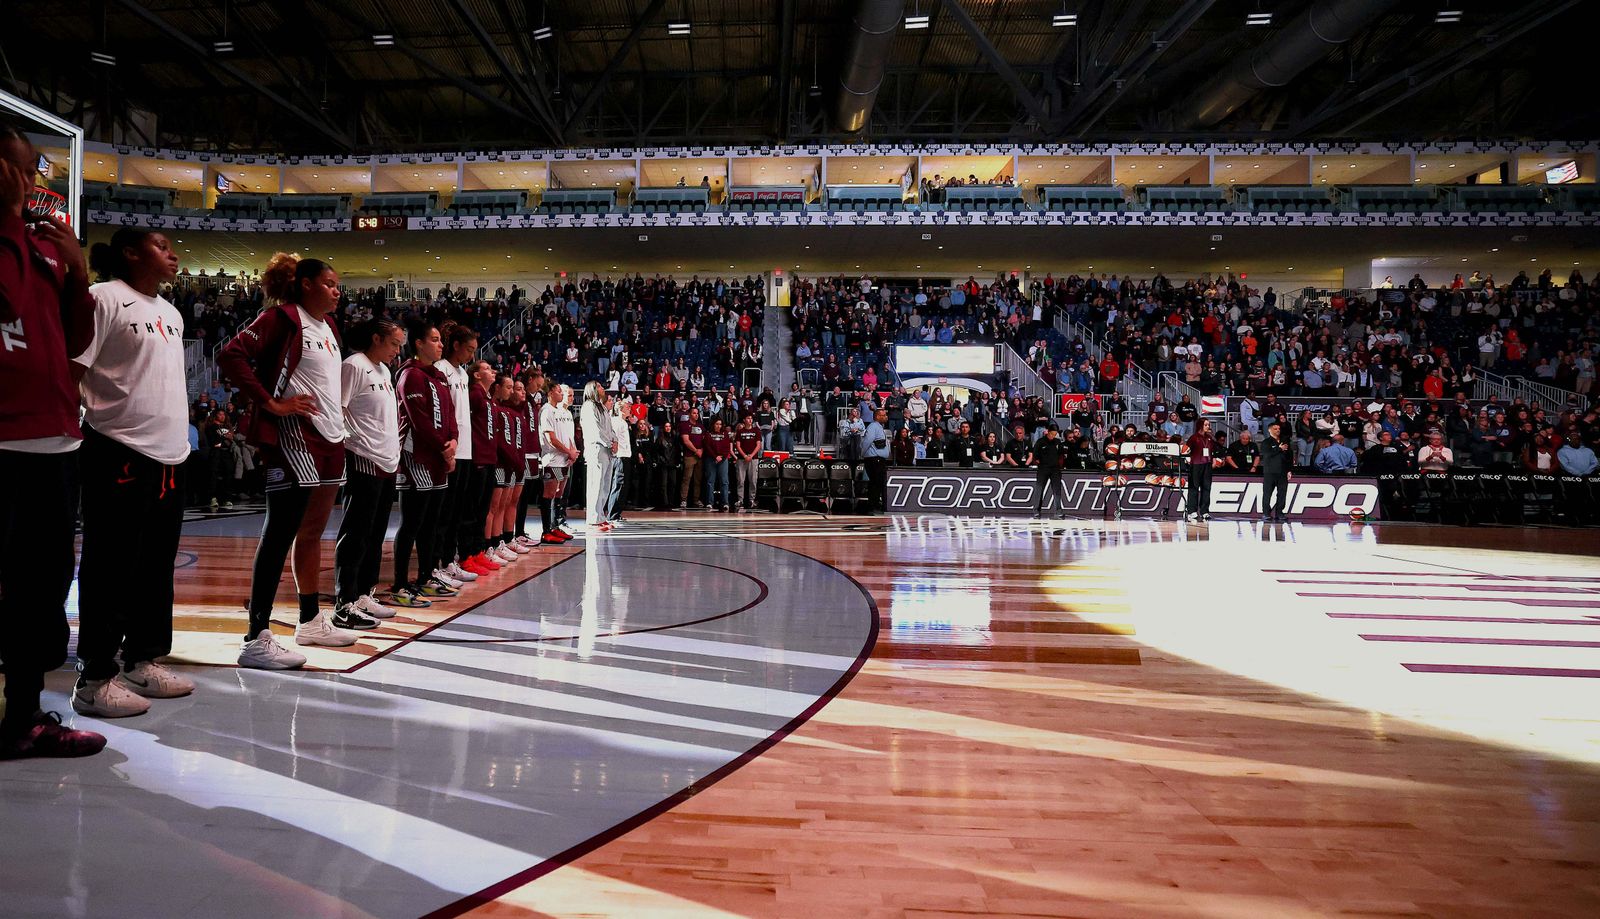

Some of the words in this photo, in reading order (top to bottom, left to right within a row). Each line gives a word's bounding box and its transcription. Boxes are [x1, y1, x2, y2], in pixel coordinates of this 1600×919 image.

[359, 218, 378, 228] 6:48
[428, 381, 443, 430] TEMPO
[486, 401, 494, 441] TEMPO
[527, 402, 536, 433] TEMPO
[1289, 404, 1331, 412] TEMPO
[515, 416, 523, 450] TEMPO
[886, 475, 1167, 512] TORONTO
